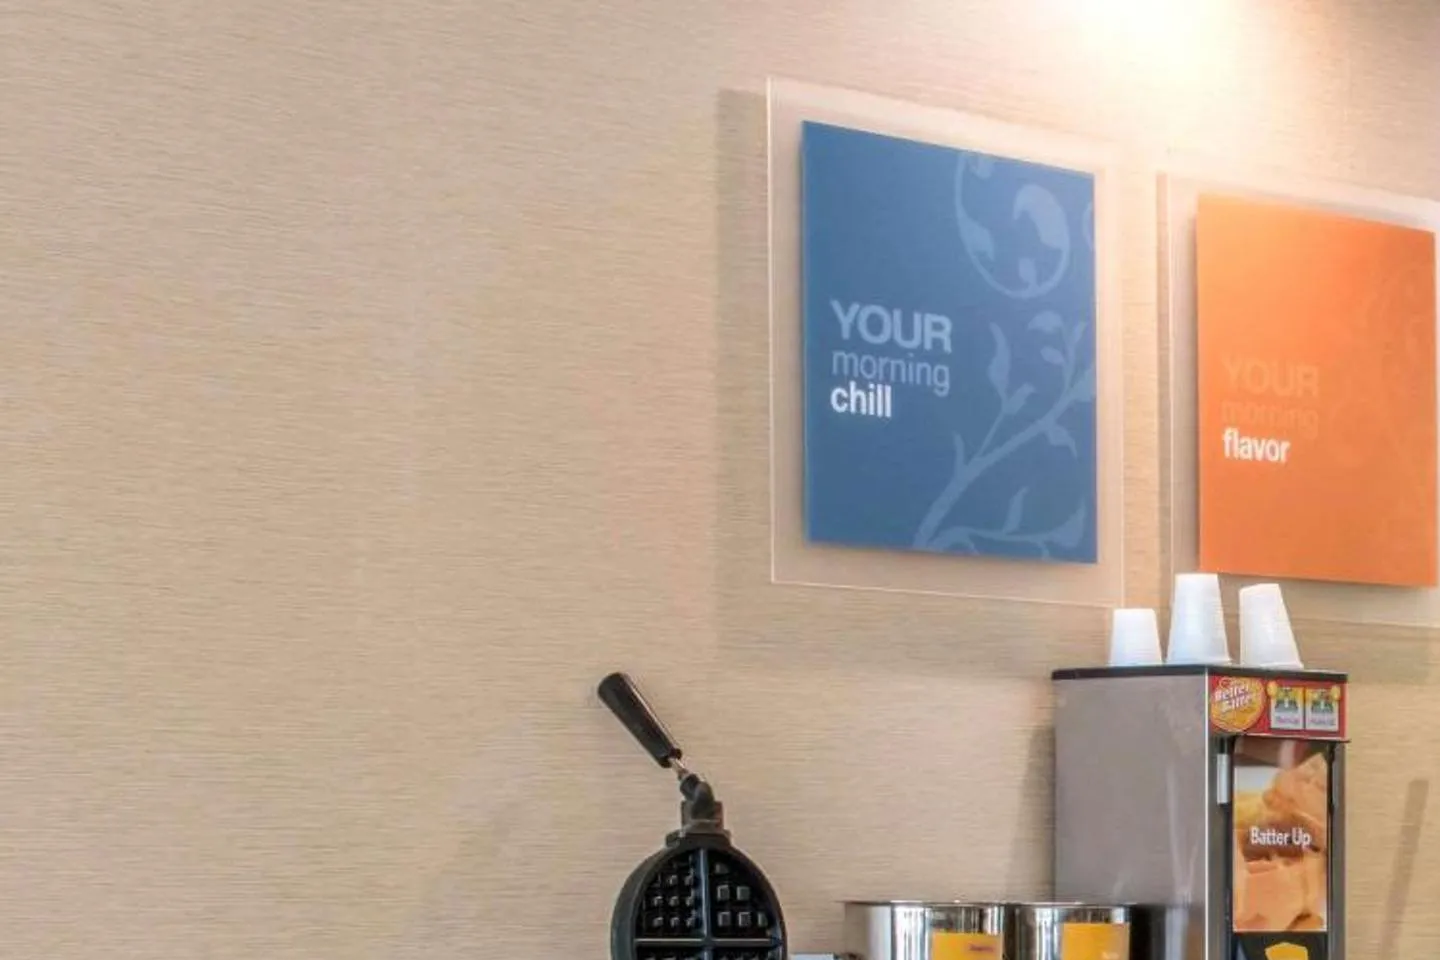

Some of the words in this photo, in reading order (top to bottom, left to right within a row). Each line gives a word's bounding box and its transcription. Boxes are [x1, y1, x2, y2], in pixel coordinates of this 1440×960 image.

[830, 299, 953, 354] YOUR
[831, 350, 951, 397] morning
[1221, 357, 1320, 398] YOUR
[830, 380, 892, 418] chill
[1221, 401, 1319, 440] morning
[1223, 426, 1291, 463] flavor
[1250, 826, 1290, 846] Batter
[1291, 827, 1312, 850] Up
